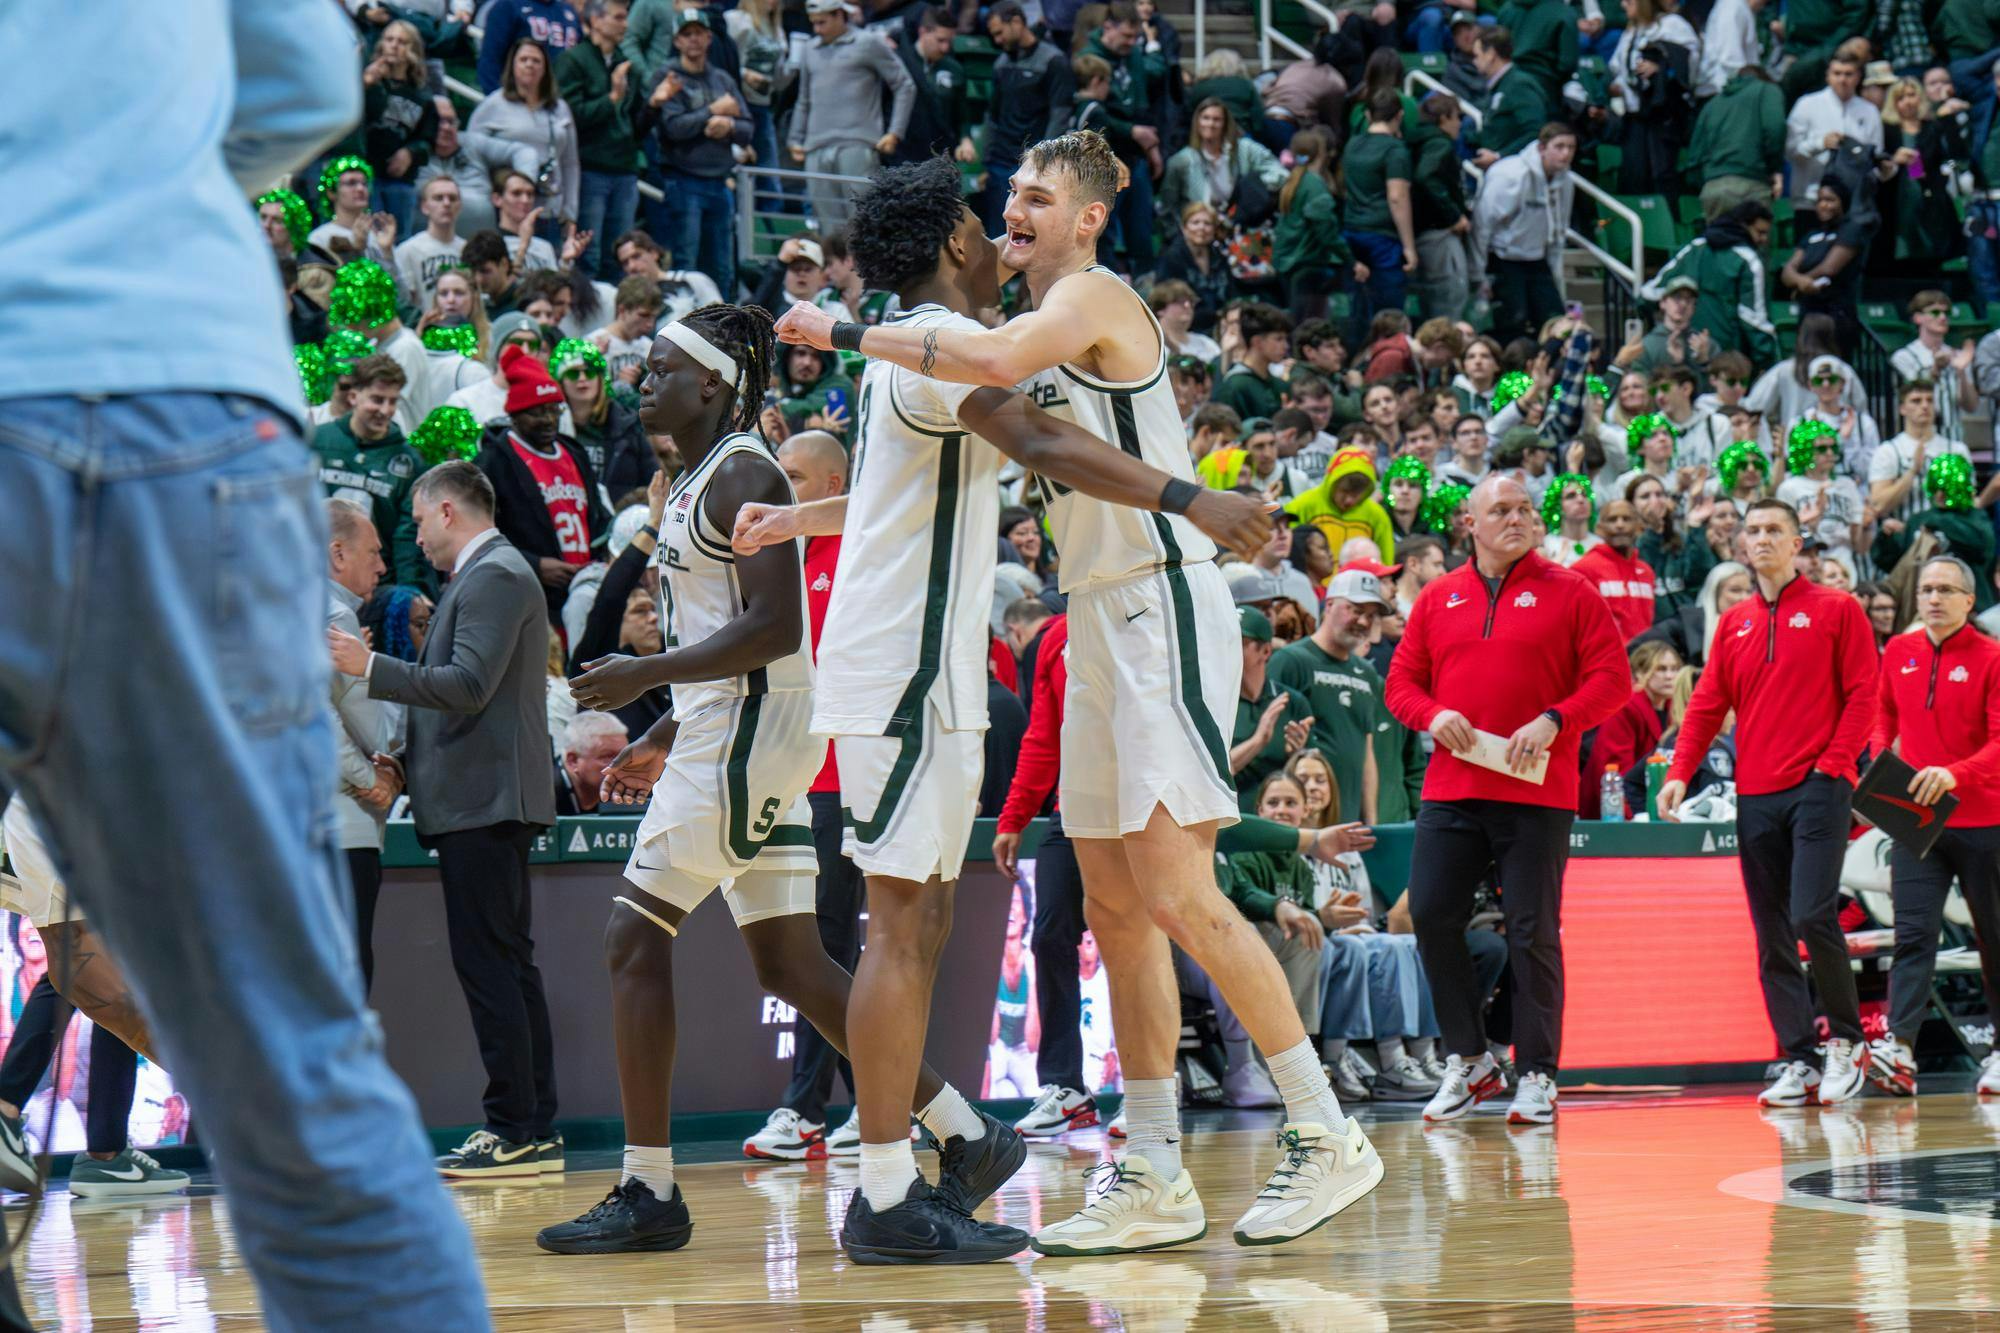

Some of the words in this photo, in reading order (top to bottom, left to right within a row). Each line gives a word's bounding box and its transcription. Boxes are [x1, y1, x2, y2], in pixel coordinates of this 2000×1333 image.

[555, 511, 589, 553] 21
[660, 575, 680, 648] 2
[752, 796, 781, 835] S
